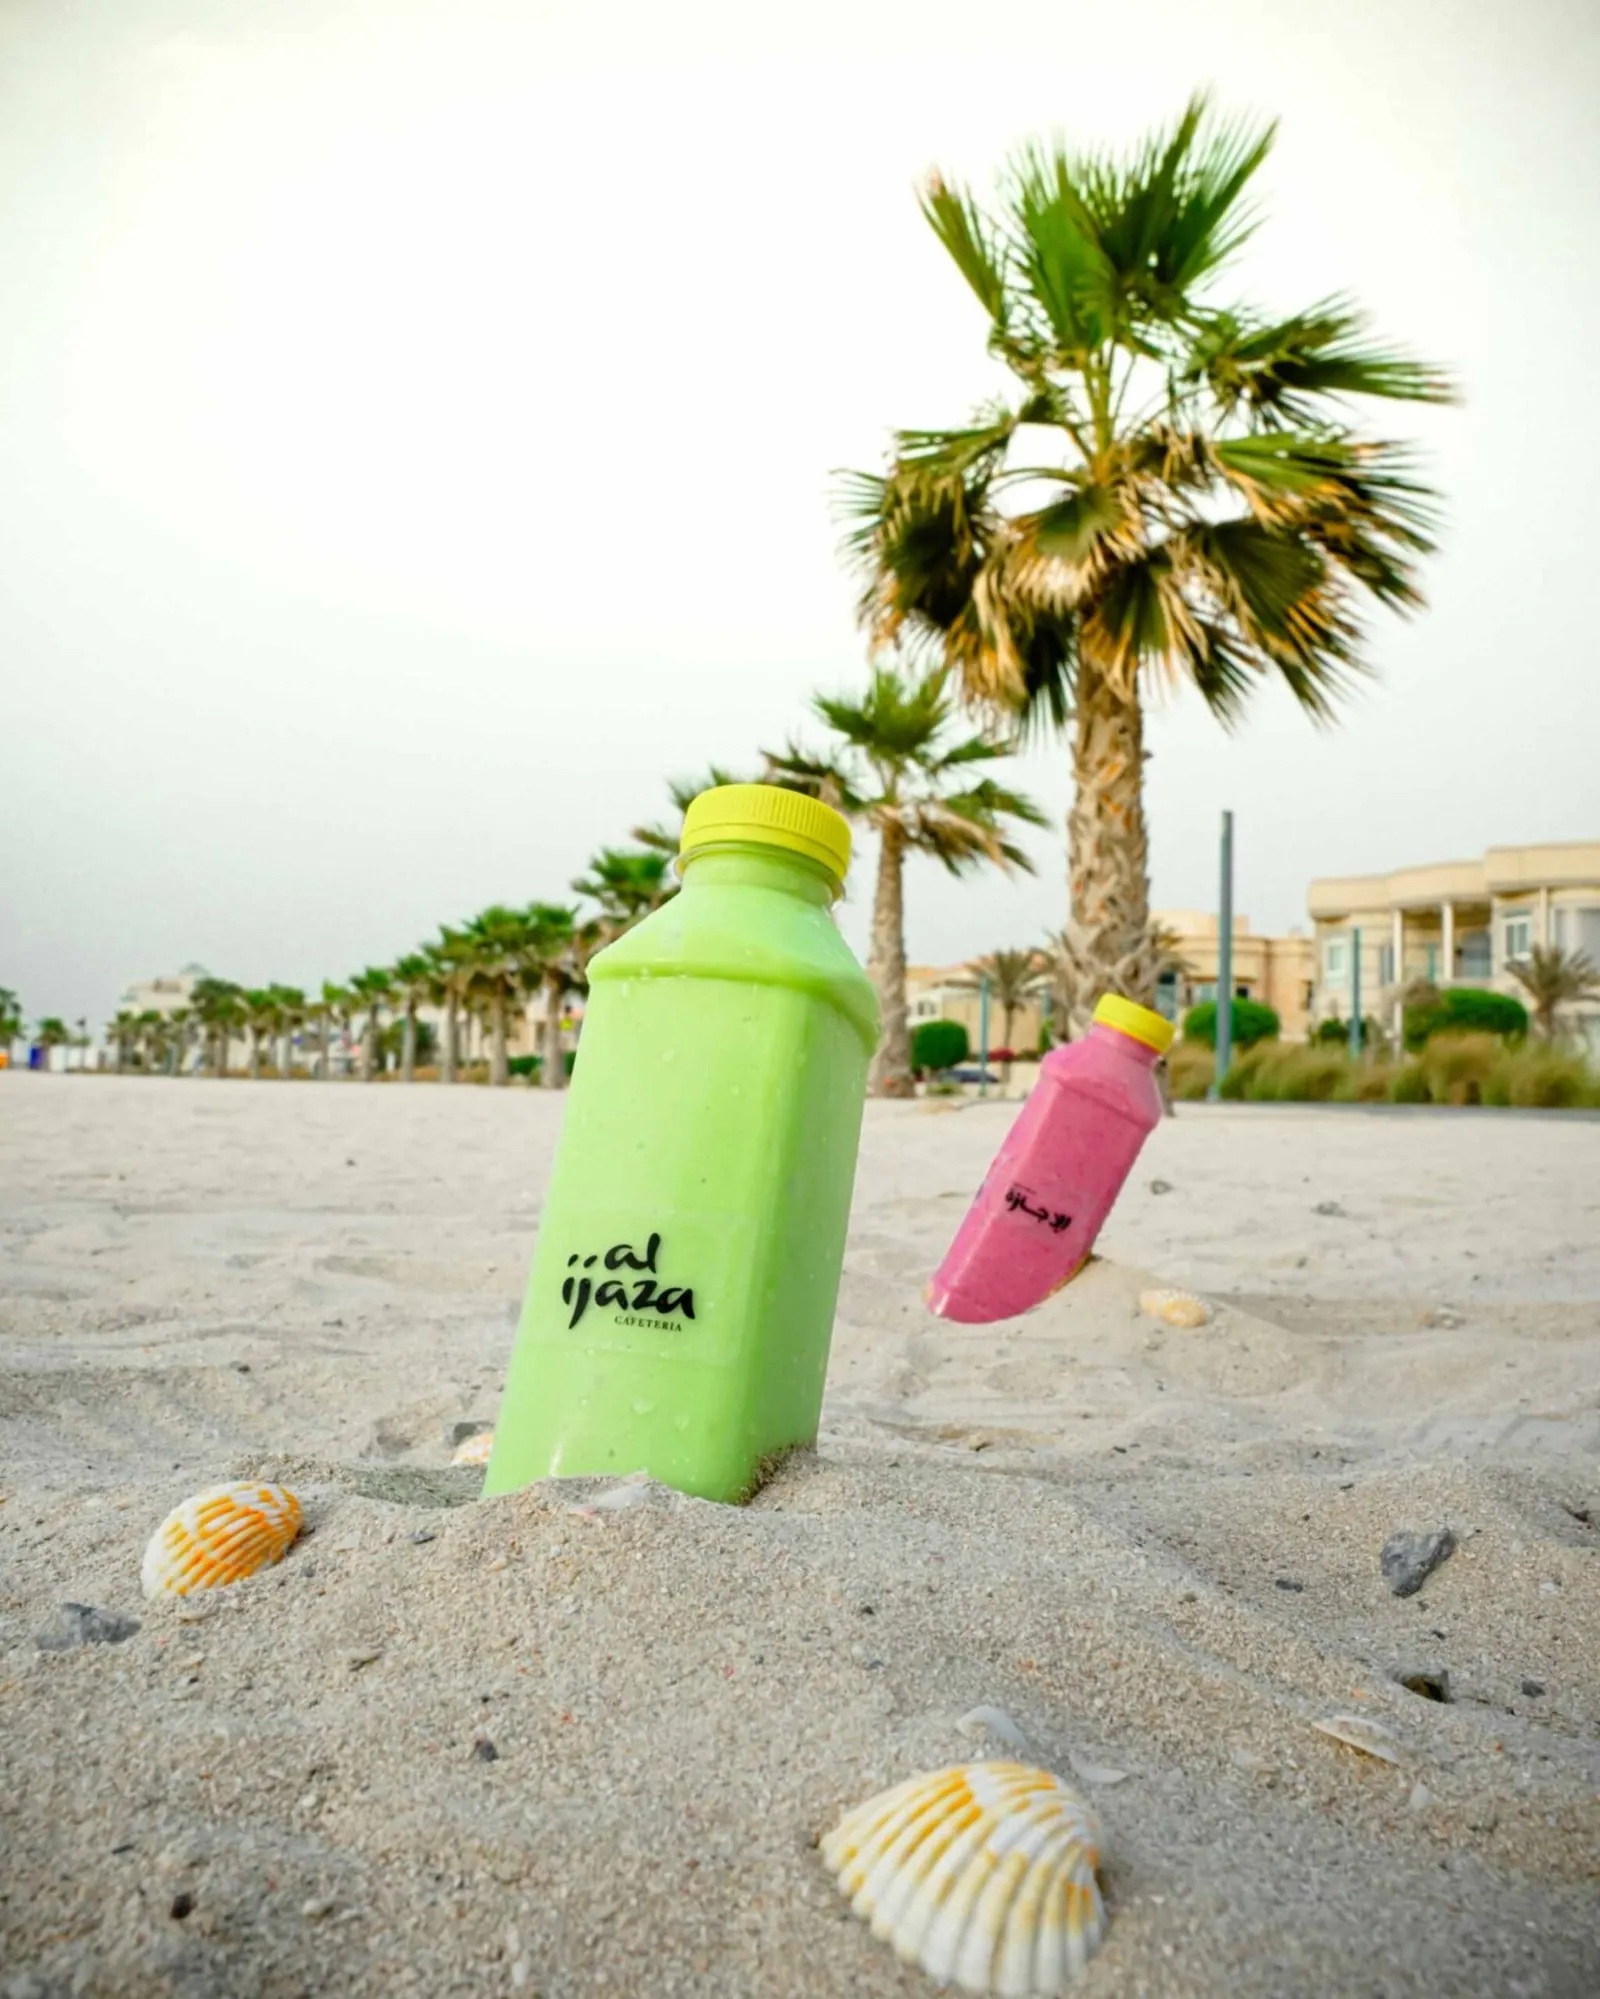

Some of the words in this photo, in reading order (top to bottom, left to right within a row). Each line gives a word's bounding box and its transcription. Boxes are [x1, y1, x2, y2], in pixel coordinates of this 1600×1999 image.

[604, 1232, 661, 1274] al
[562, 1254, 696, 1329] ijaza
[614, 1316, 682, 1332] CAFETERIA
